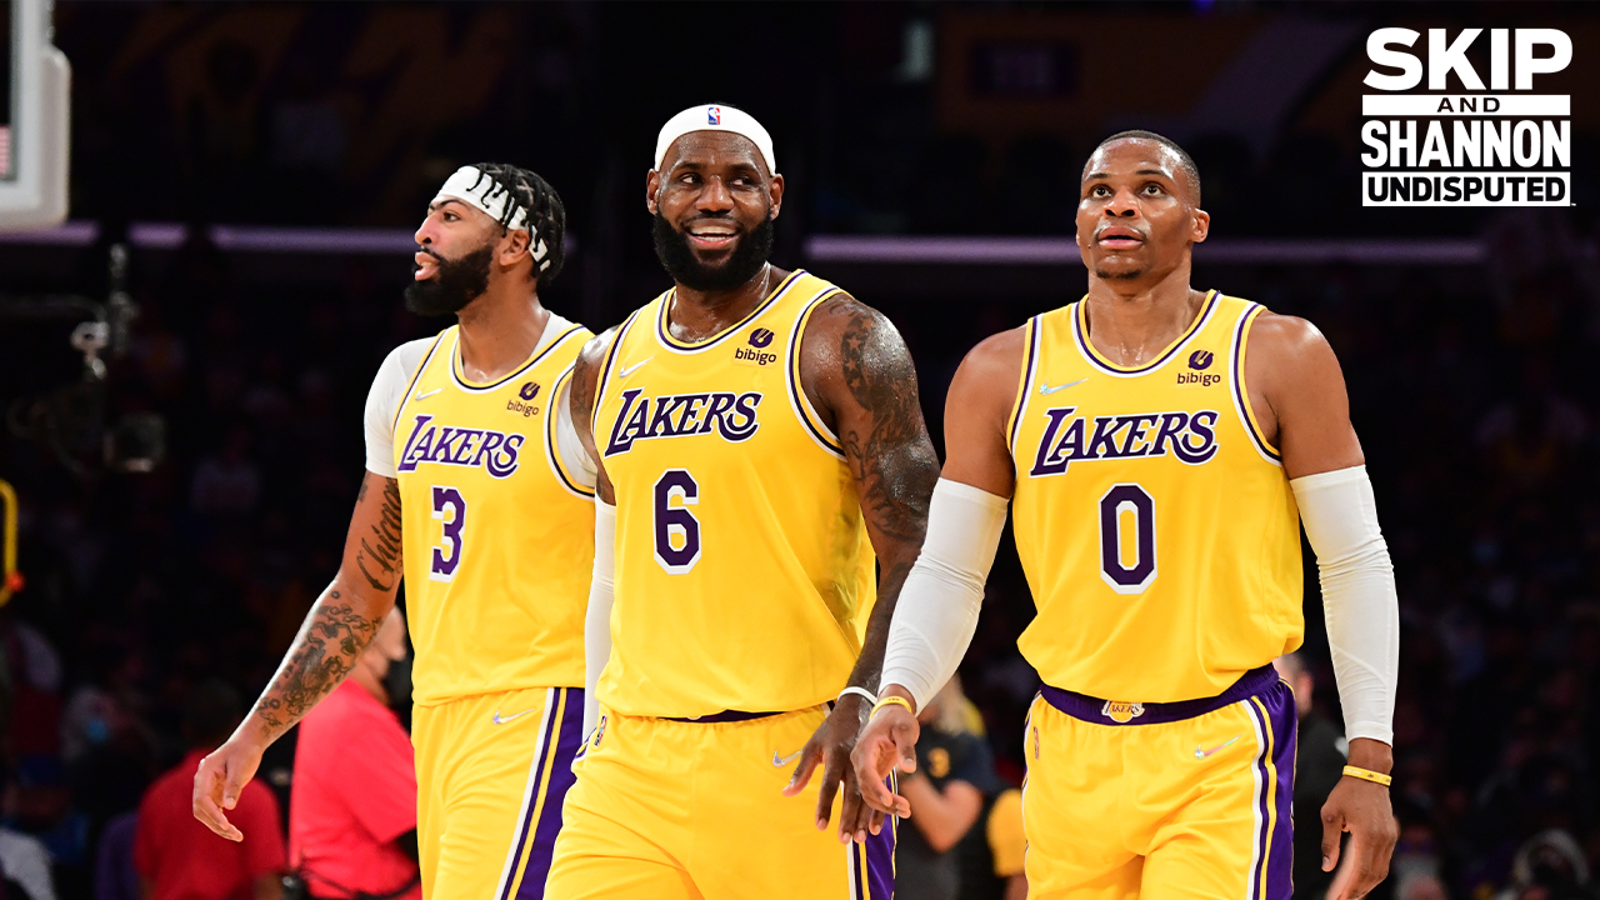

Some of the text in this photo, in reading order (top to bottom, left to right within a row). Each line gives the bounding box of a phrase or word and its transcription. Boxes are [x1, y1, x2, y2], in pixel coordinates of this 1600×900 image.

[735, 348, 777, 365] bibigo
[1177, 373, 1221, 386] bibigo
[507, 400, 539, 417] bibigo
[604, 387, 764, 459] LAKERS
[1029, 406, 1220, 478] LAKERS
[397, 414, 526, 479] LAKERS
[429, 485, 467, 583] 3
[653, 468, 702, 575] 6
[1098, 482, 1158, 595] 0
